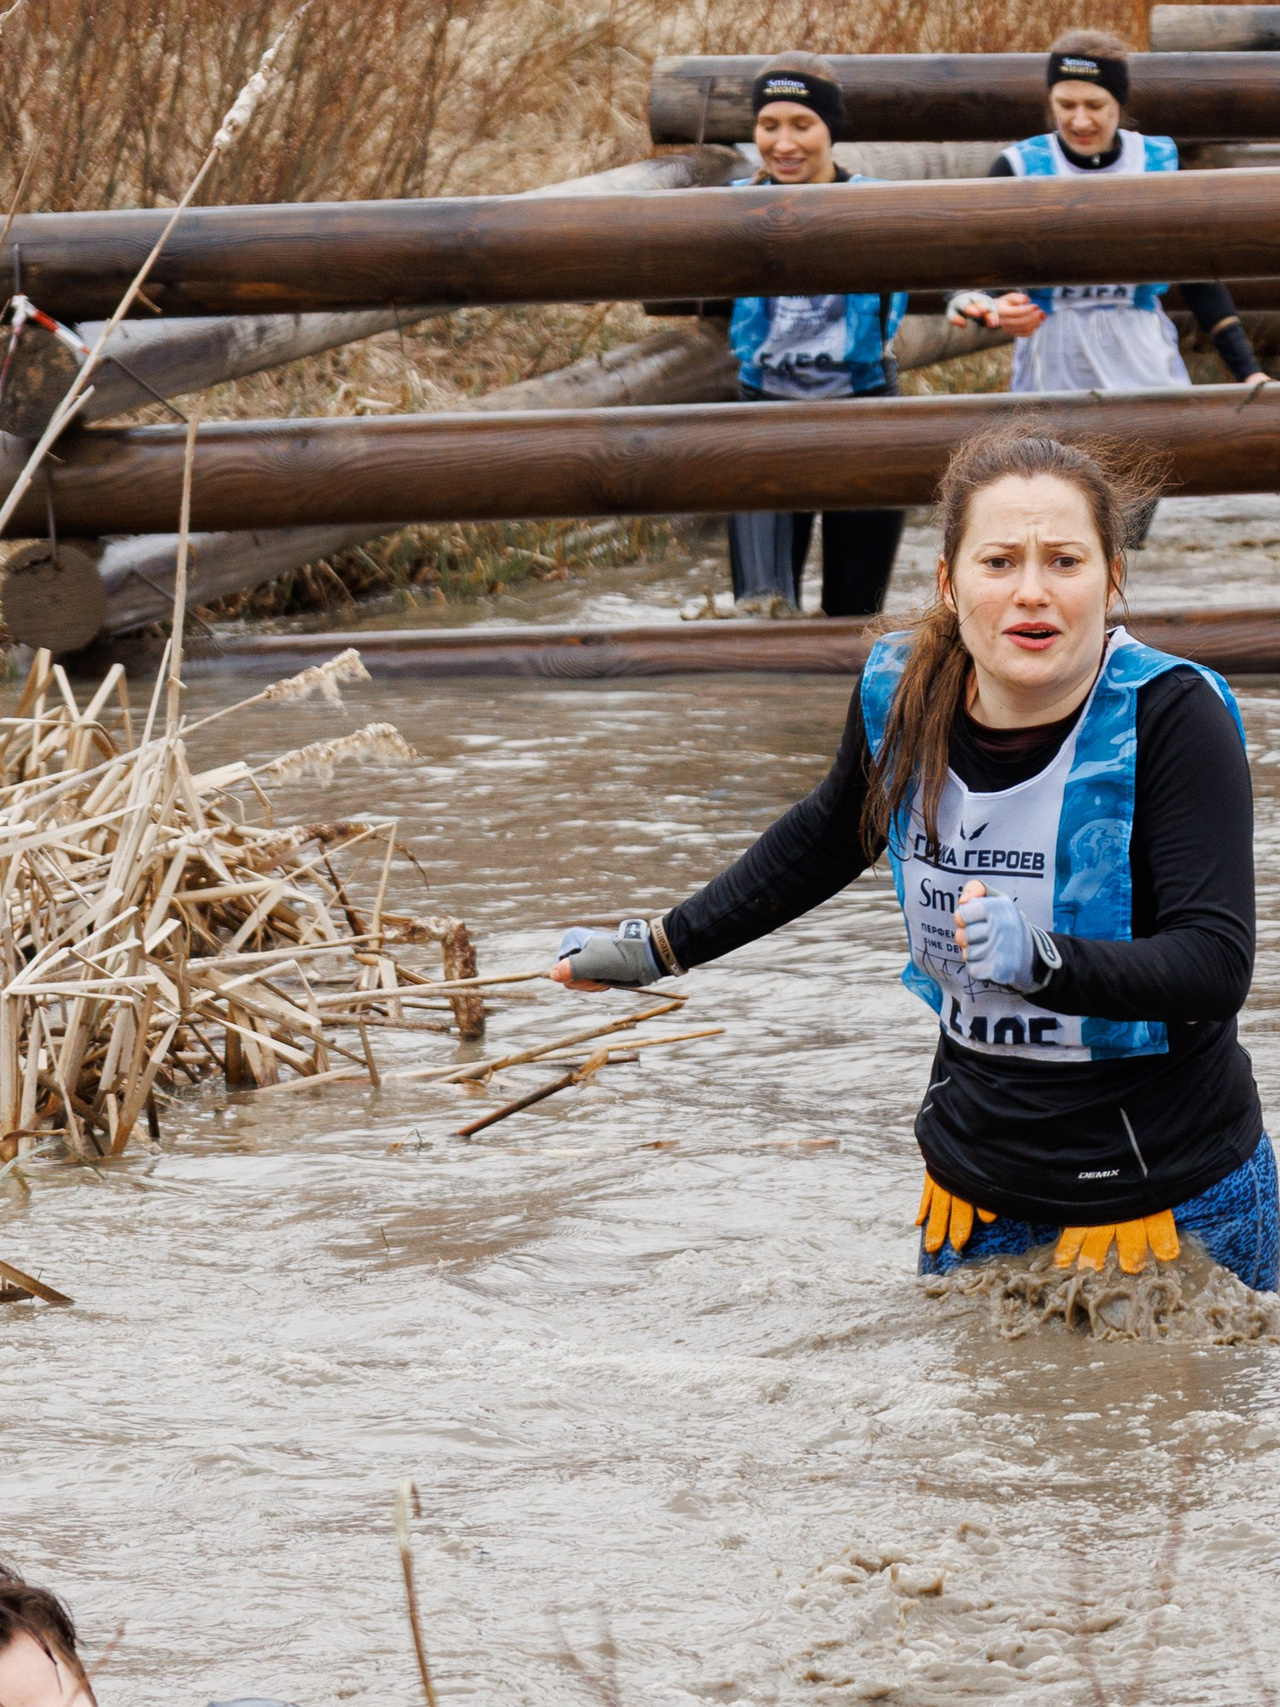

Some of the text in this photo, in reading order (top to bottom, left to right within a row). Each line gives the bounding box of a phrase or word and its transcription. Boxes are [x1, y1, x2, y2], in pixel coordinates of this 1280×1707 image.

[766, 78, 806, 89] Sminex
[913, 833, 1046, 871] ГОКА ГЕРОЕВ
[923, 937, 943, 950] FINE
[1078, 1169, 1120, 1179] DEMIX
